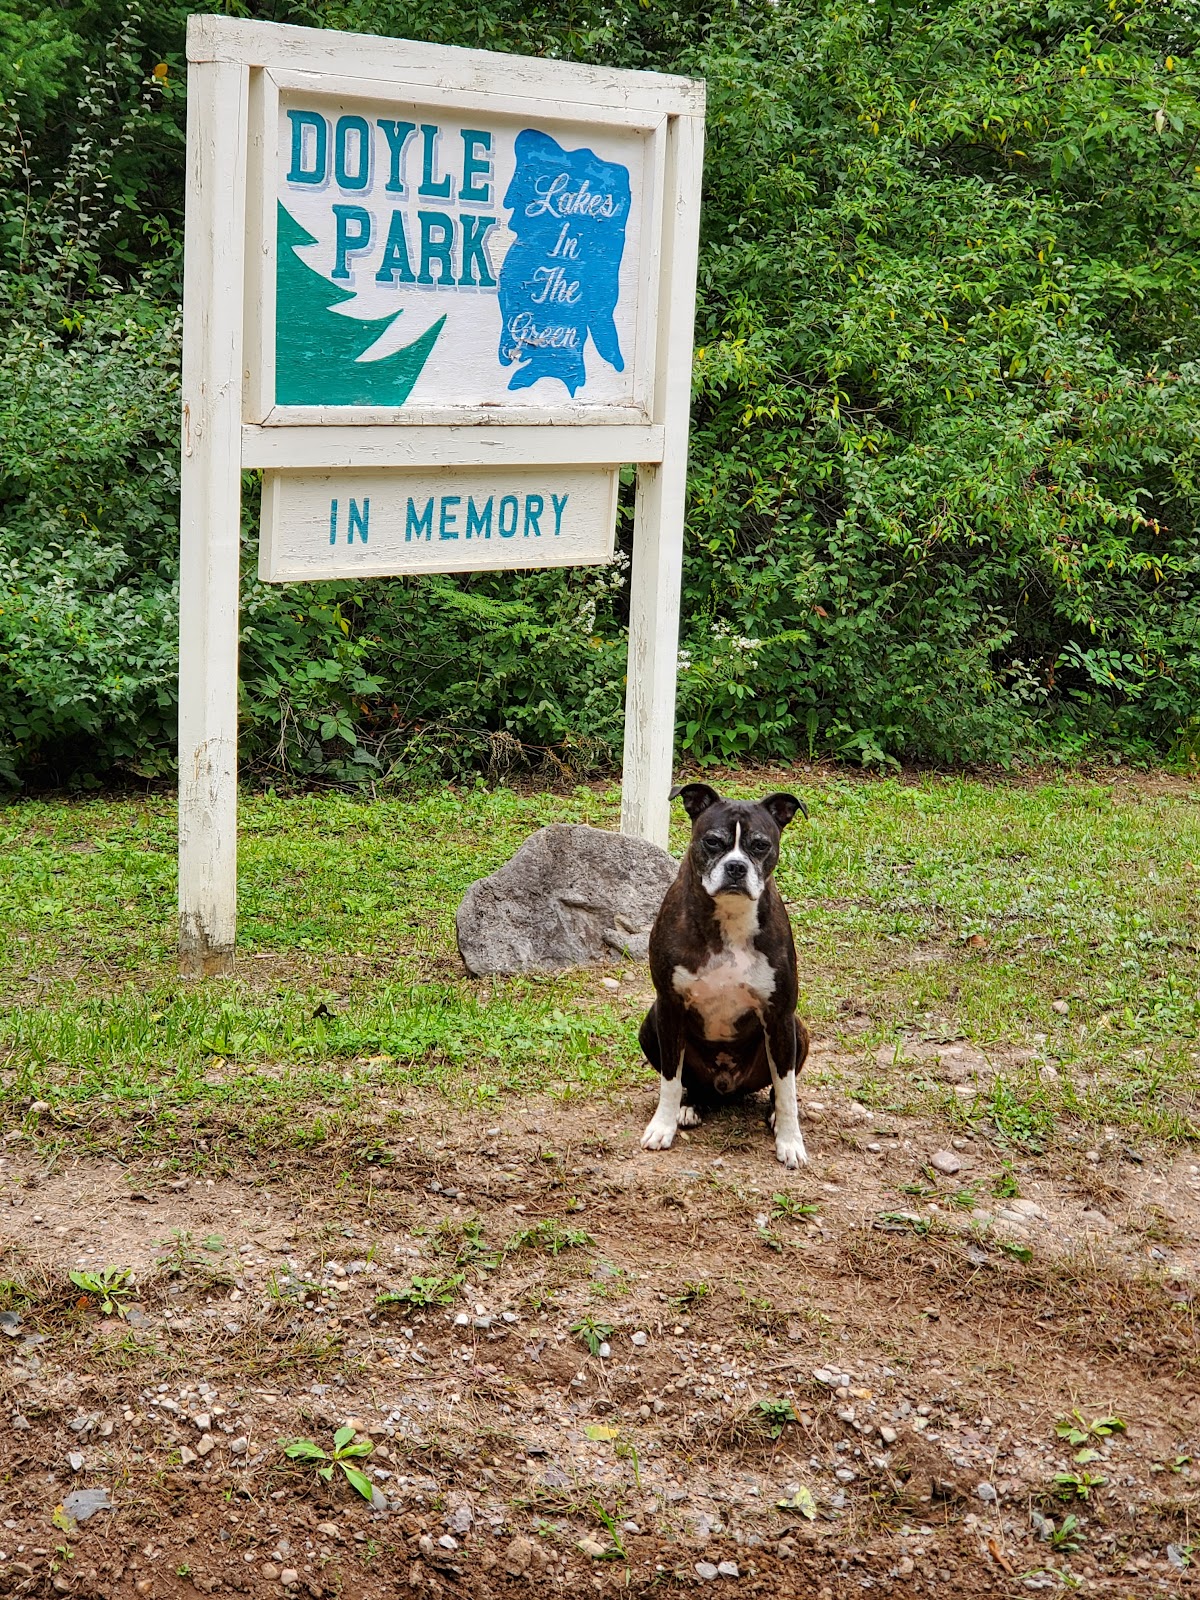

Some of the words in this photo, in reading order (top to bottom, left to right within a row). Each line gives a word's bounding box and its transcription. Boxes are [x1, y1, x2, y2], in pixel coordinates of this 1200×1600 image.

[286, 109, 494, 205] DOYLE
[525, 173, 619, 217] Lakes
[330, 203, 500, 290] PARK
[547, 222, 582, 260] In
[530, 266, 582, 304] The
[504, 312, 580, 354] Green
[329, 497, 371, 546] IN
[405, 493, 571, 542] MEMORY
